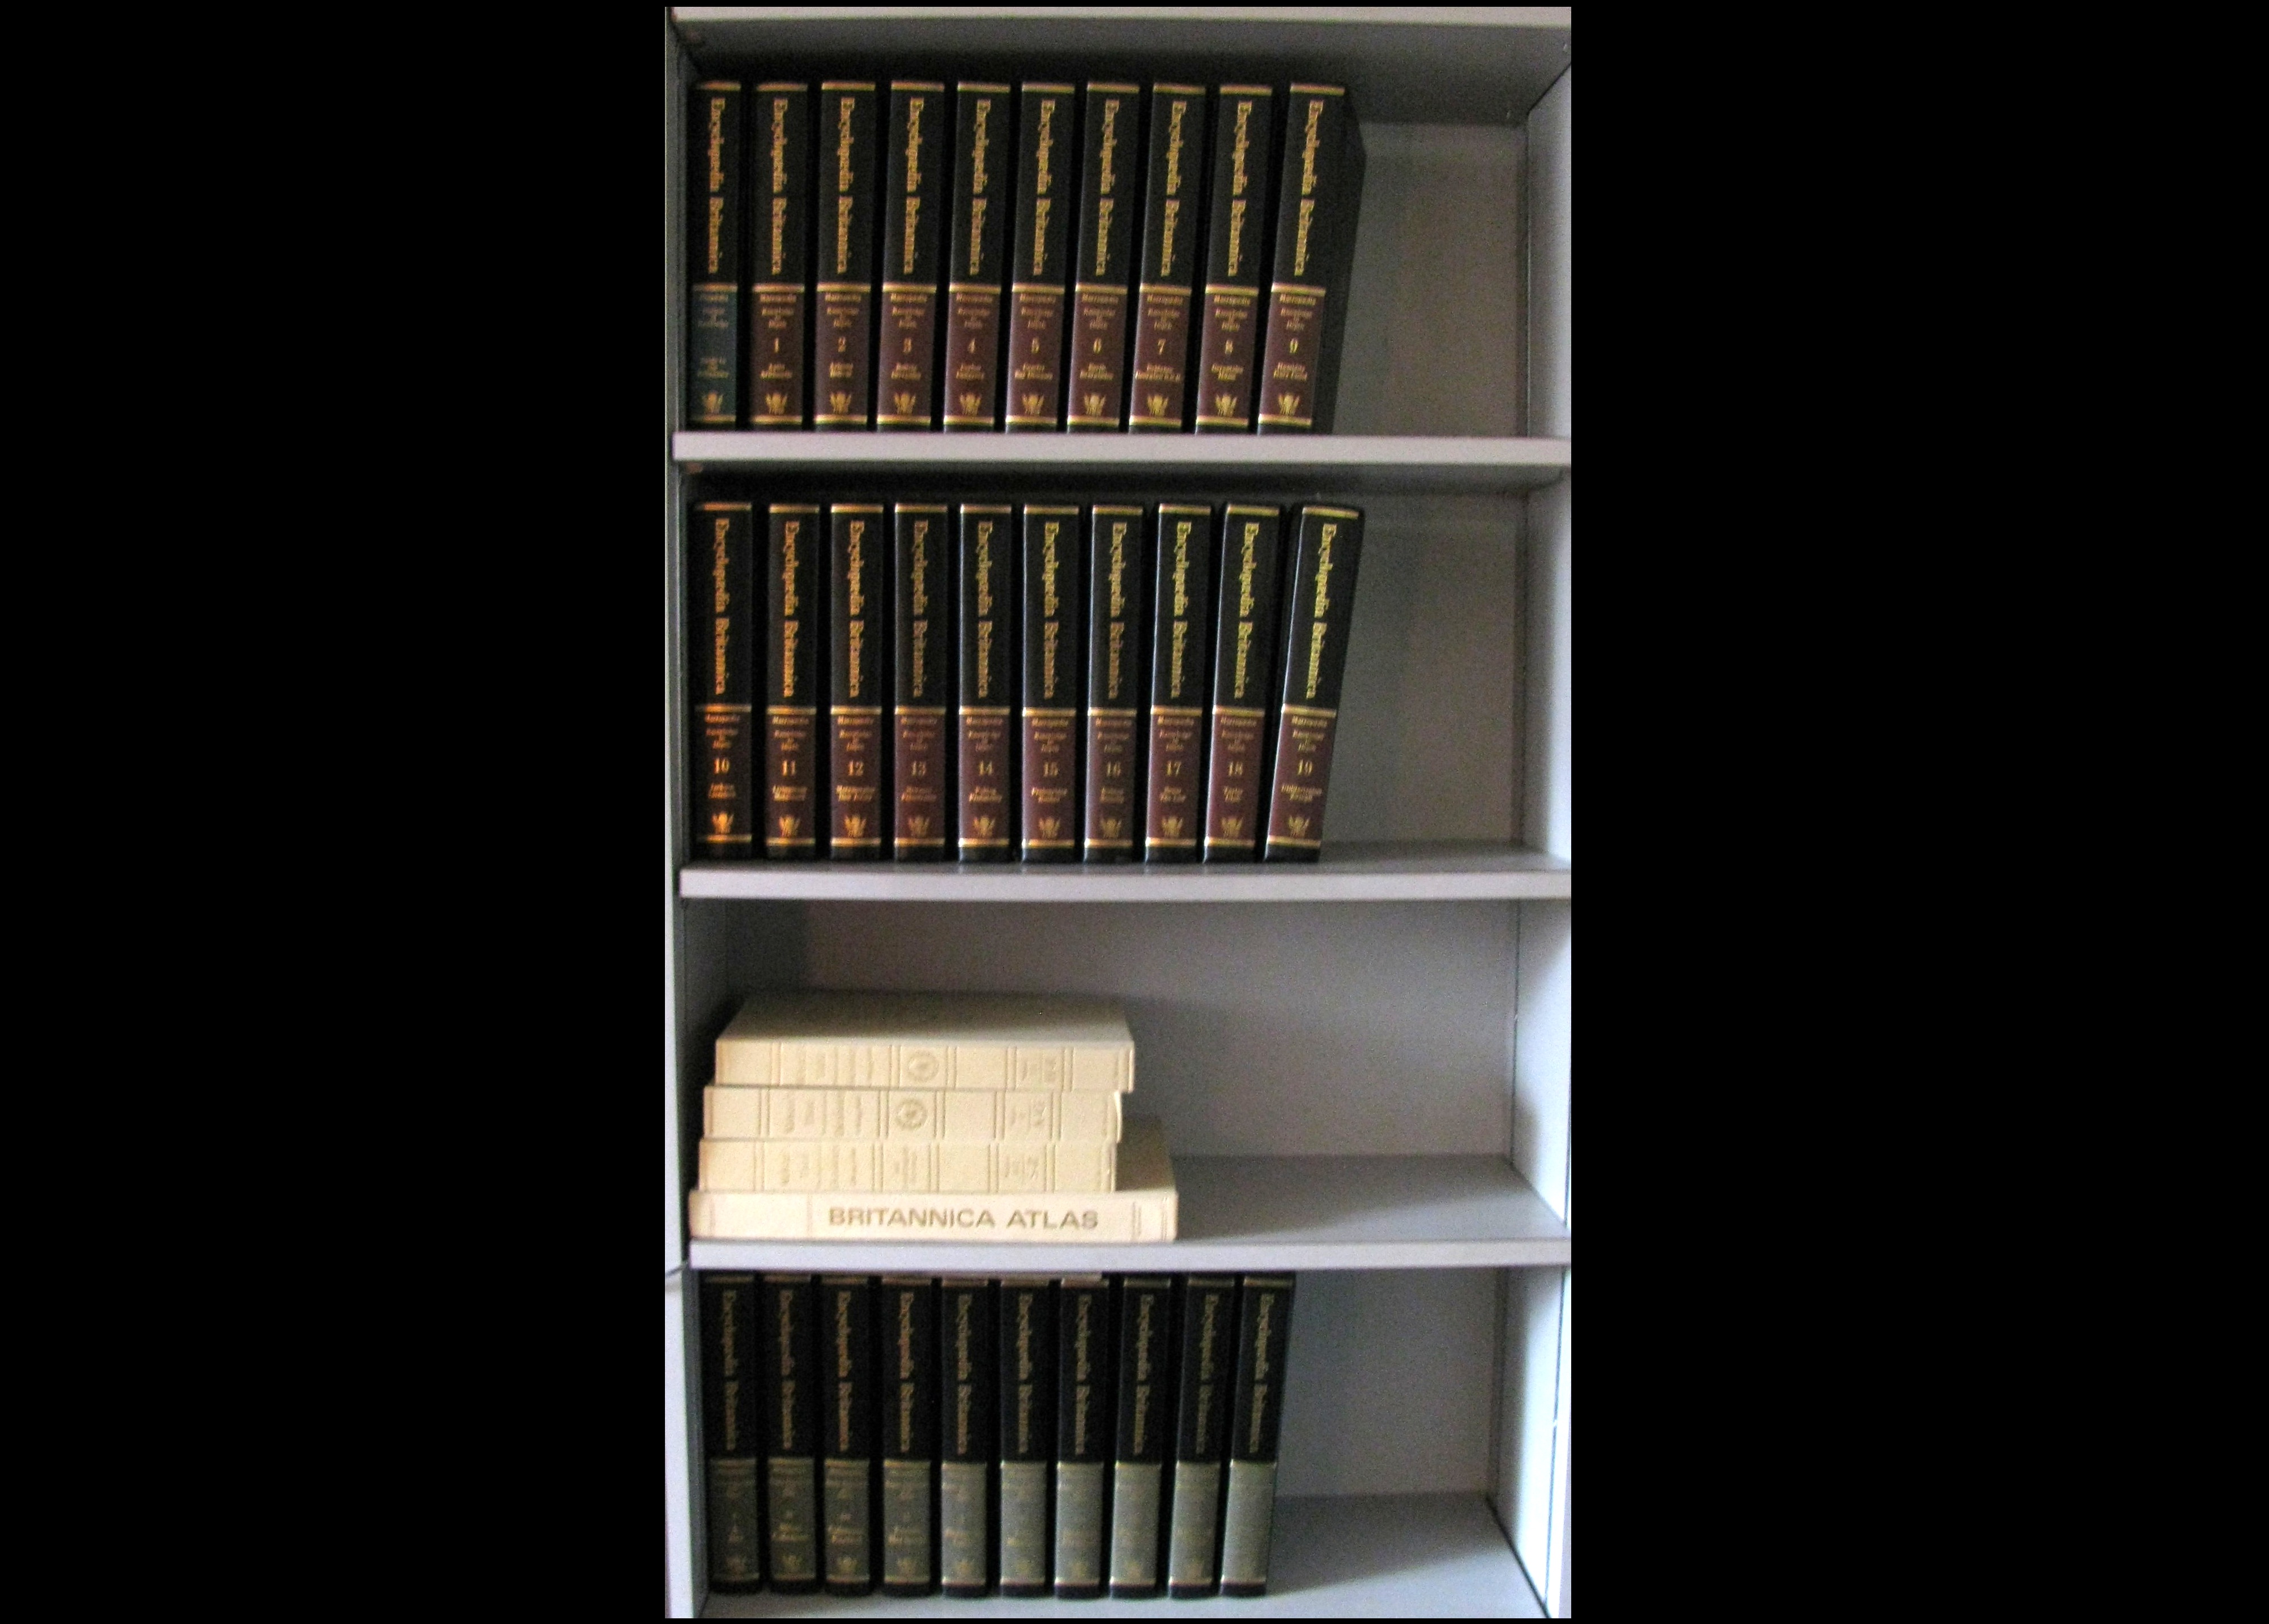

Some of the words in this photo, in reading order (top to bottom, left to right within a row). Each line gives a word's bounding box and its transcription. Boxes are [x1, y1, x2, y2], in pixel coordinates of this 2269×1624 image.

[774, 337, 779, 353] 1
[838, 337, 847, 352] 2
[967, 337, 977, 353] 4
[1157, 338, 1166, 356] 7
[713, 758, 731, 774] 10
[782, 760, 797, 776] 11
[848, 759, 865, 776] 12
[910, 760, 927, 777] 13
[978, 760, 994, 776] 14
[1166, 760, 1182, 777] 17
[829, 1206, 997, 1229] BRITANNICA
[1006, 1209, 1100, 1229] ATLAS
